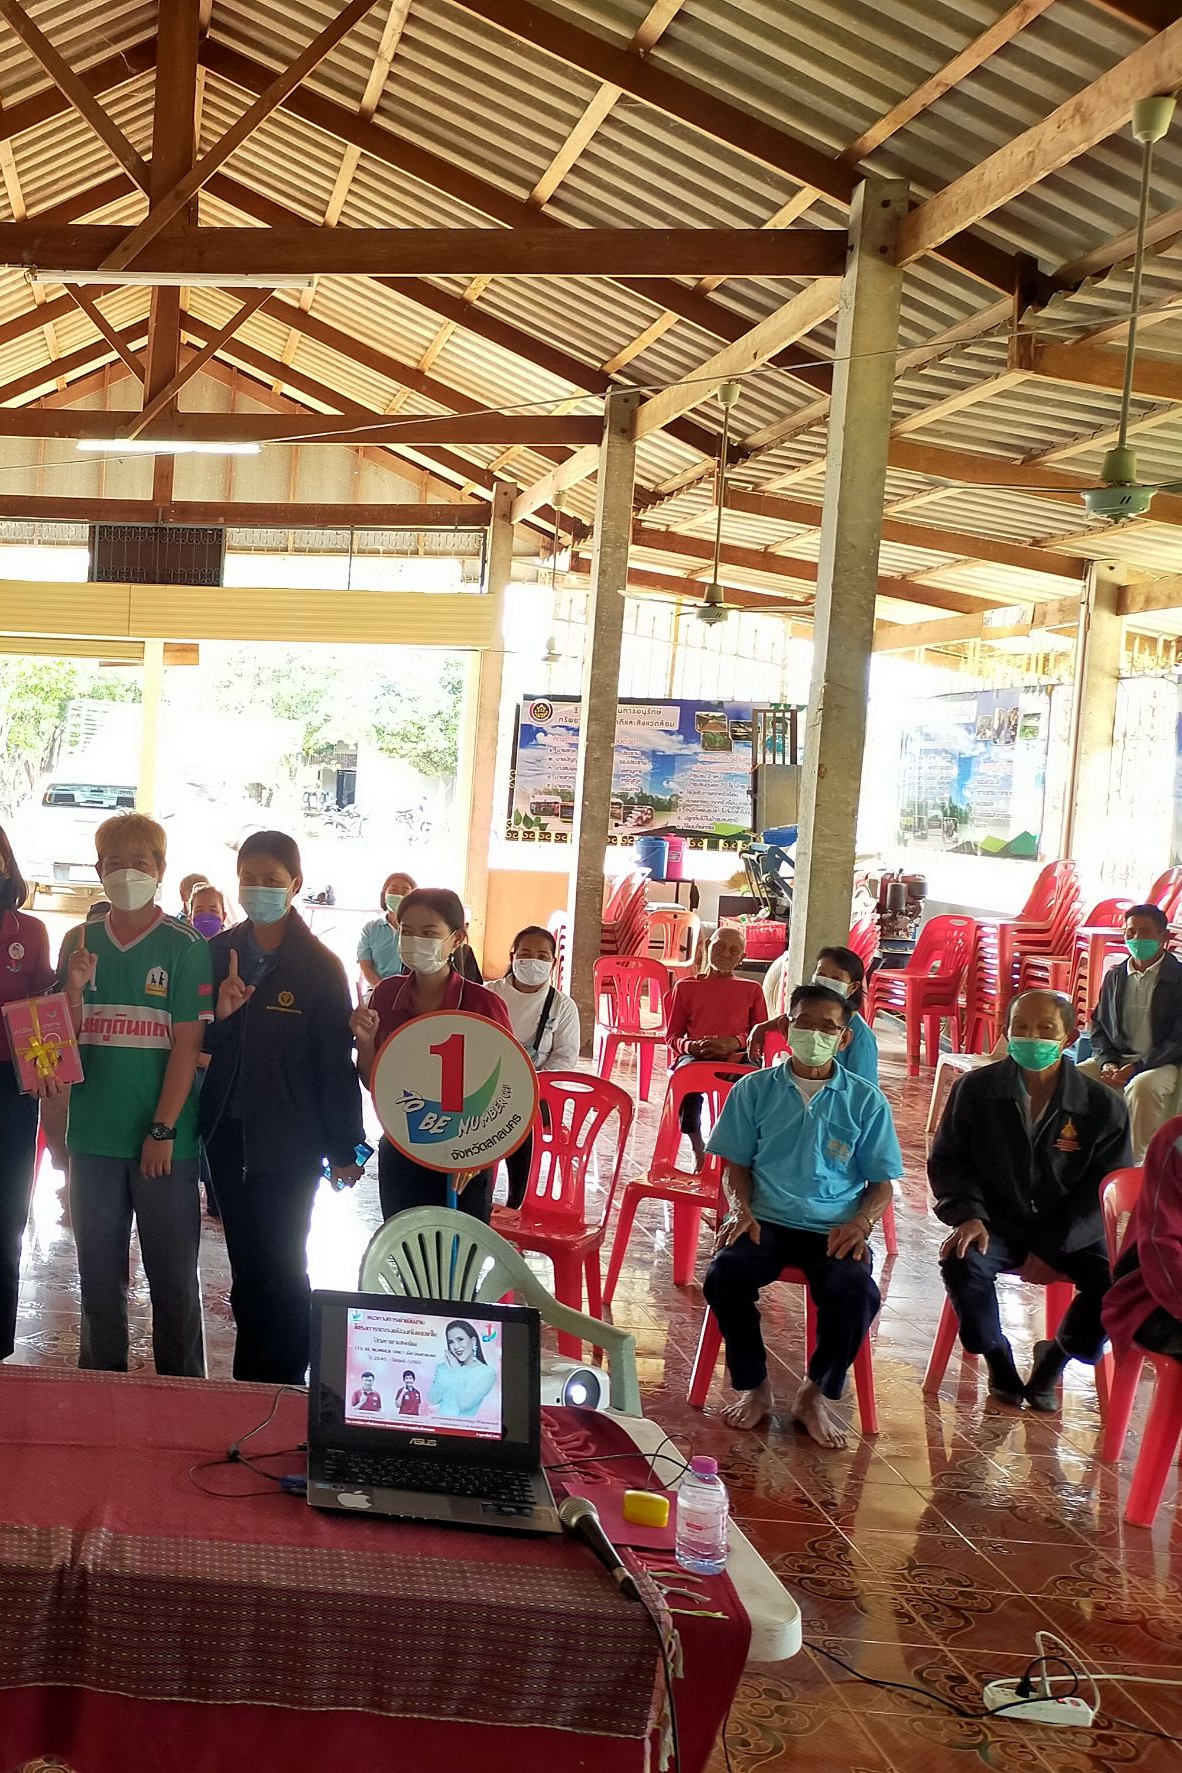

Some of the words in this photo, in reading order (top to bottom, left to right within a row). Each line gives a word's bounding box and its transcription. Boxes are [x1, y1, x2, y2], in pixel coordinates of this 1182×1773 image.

[429, 1033, 466, 1113] 1
[418, 1112, 453, 1136] BE
[457, 1096, 508, 1138] NUMBER
[450, 1113, 522, 1161] จังหวัดสกลนคร
[409, 1437, 438, 1447] ASUS
